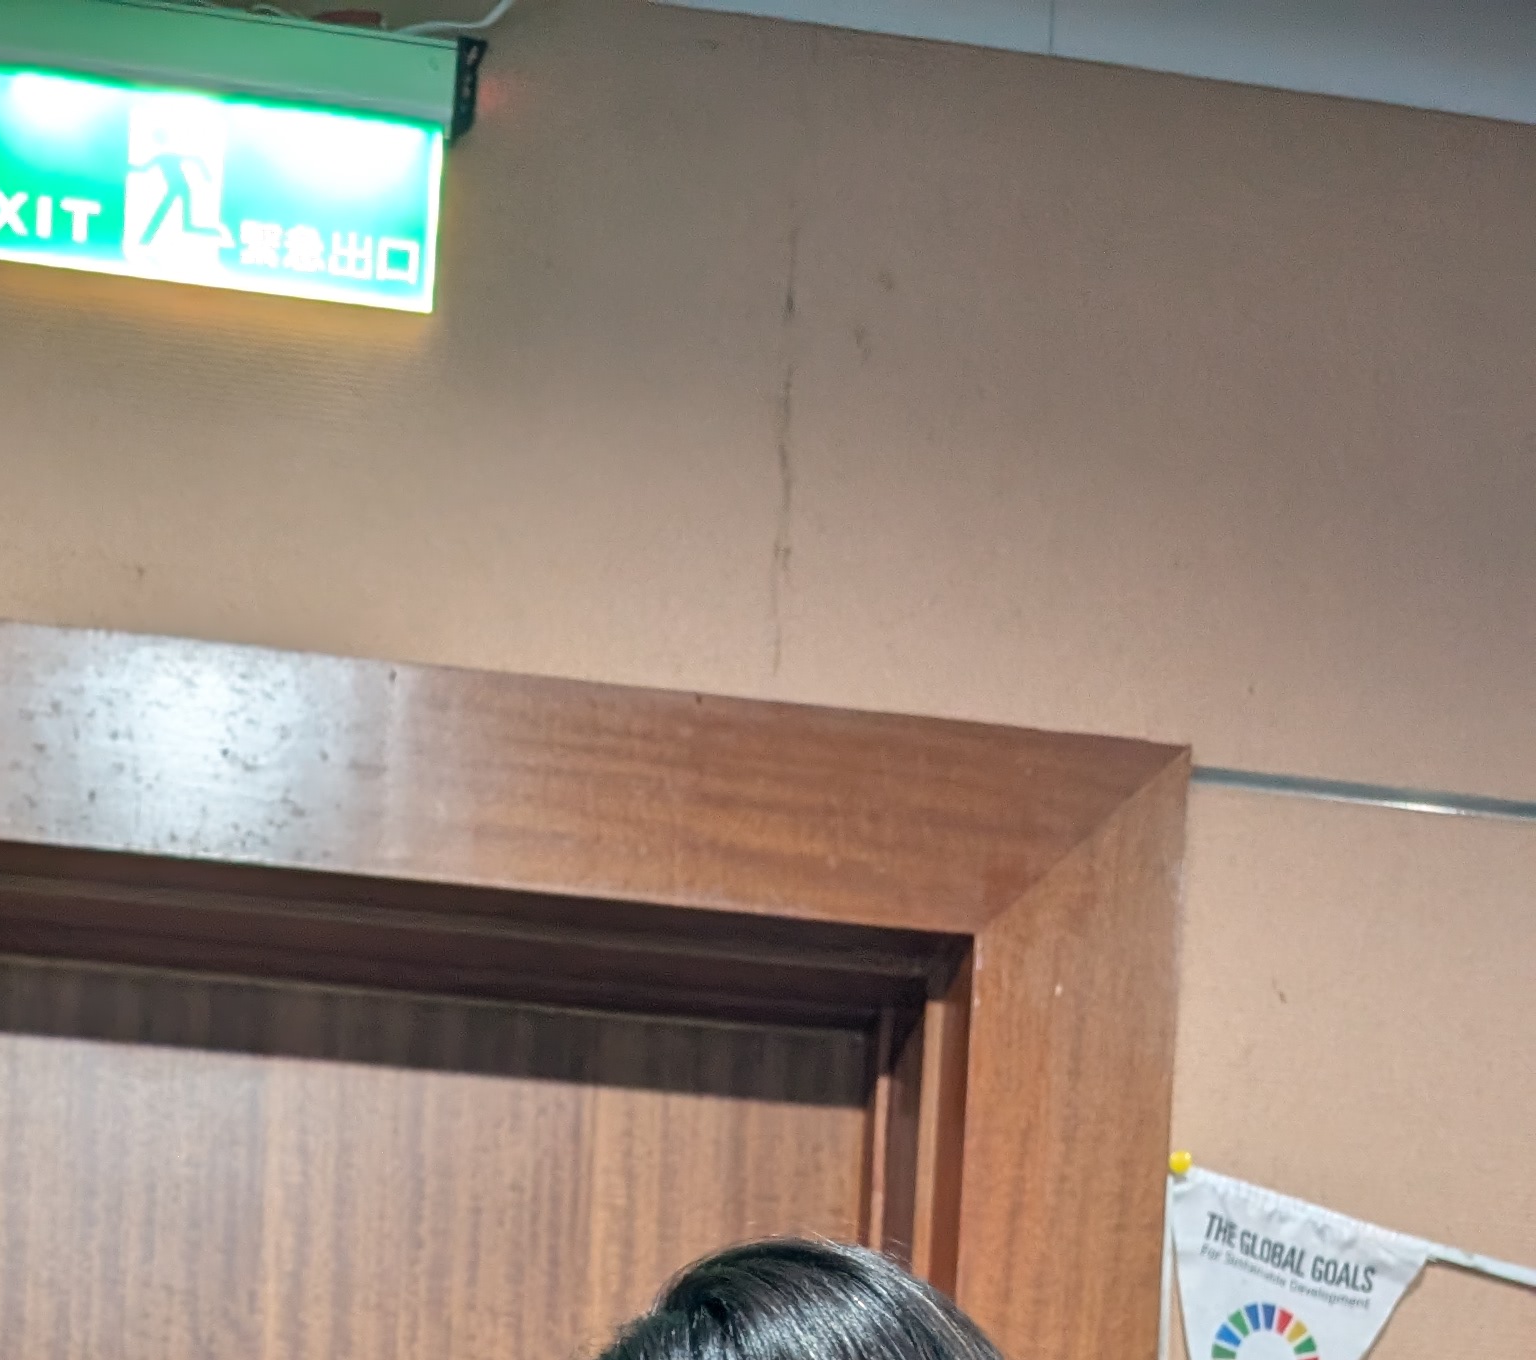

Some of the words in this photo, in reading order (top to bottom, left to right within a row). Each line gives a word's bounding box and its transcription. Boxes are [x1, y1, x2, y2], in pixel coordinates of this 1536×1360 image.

[240, 219, 420, 284] 緊急出口
[1200, 1243, 1222, 1260] For
[1205, 1211, 1237, 1248] THE
[1240, 1229, 1306, 1278] GLOBAL
[1311, 1255, 1376, 1293] GOALS
